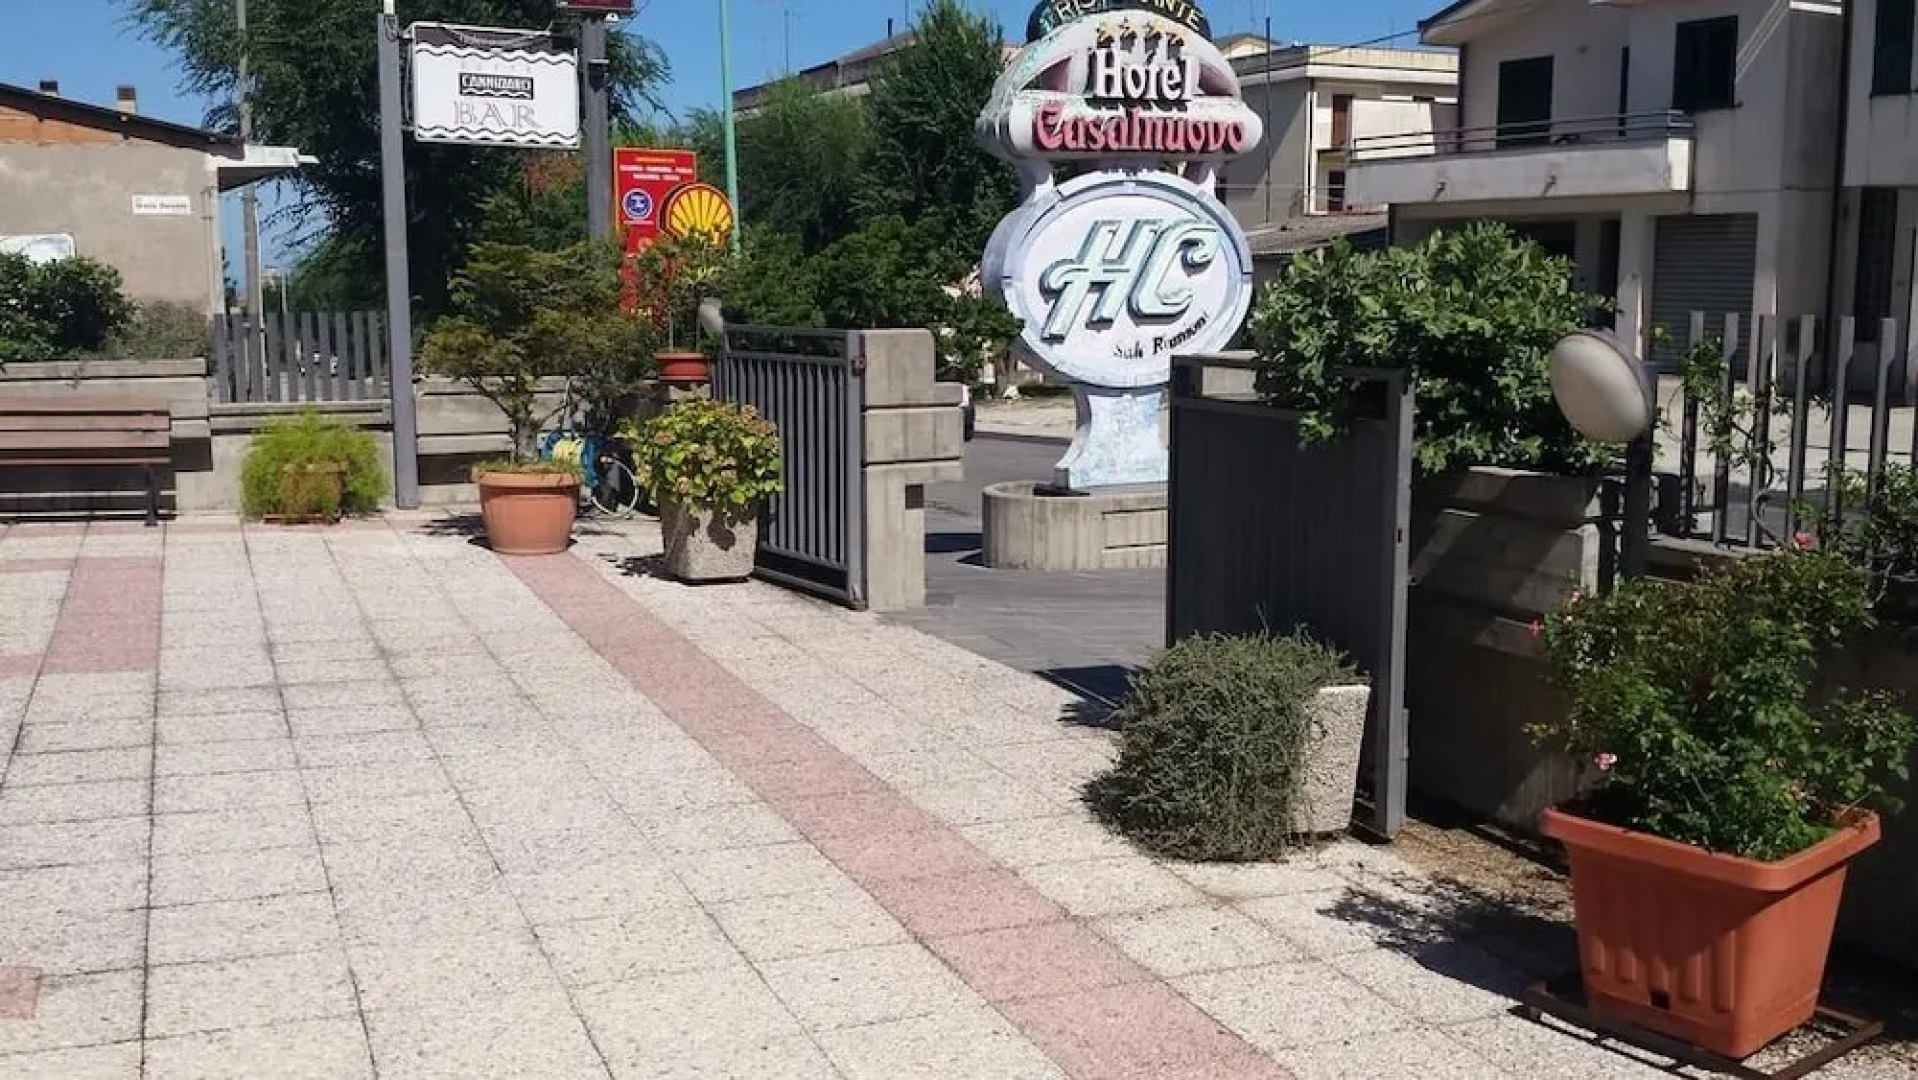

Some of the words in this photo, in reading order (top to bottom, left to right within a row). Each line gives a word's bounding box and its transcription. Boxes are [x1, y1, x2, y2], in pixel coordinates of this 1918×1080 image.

[1092, 47, 1204, 99] Hotel
[452, 101, 543, 128] BAR
[1034, 101, 1246, 151] Casalnuovo
[1039, 218, 1219, 344] HC
